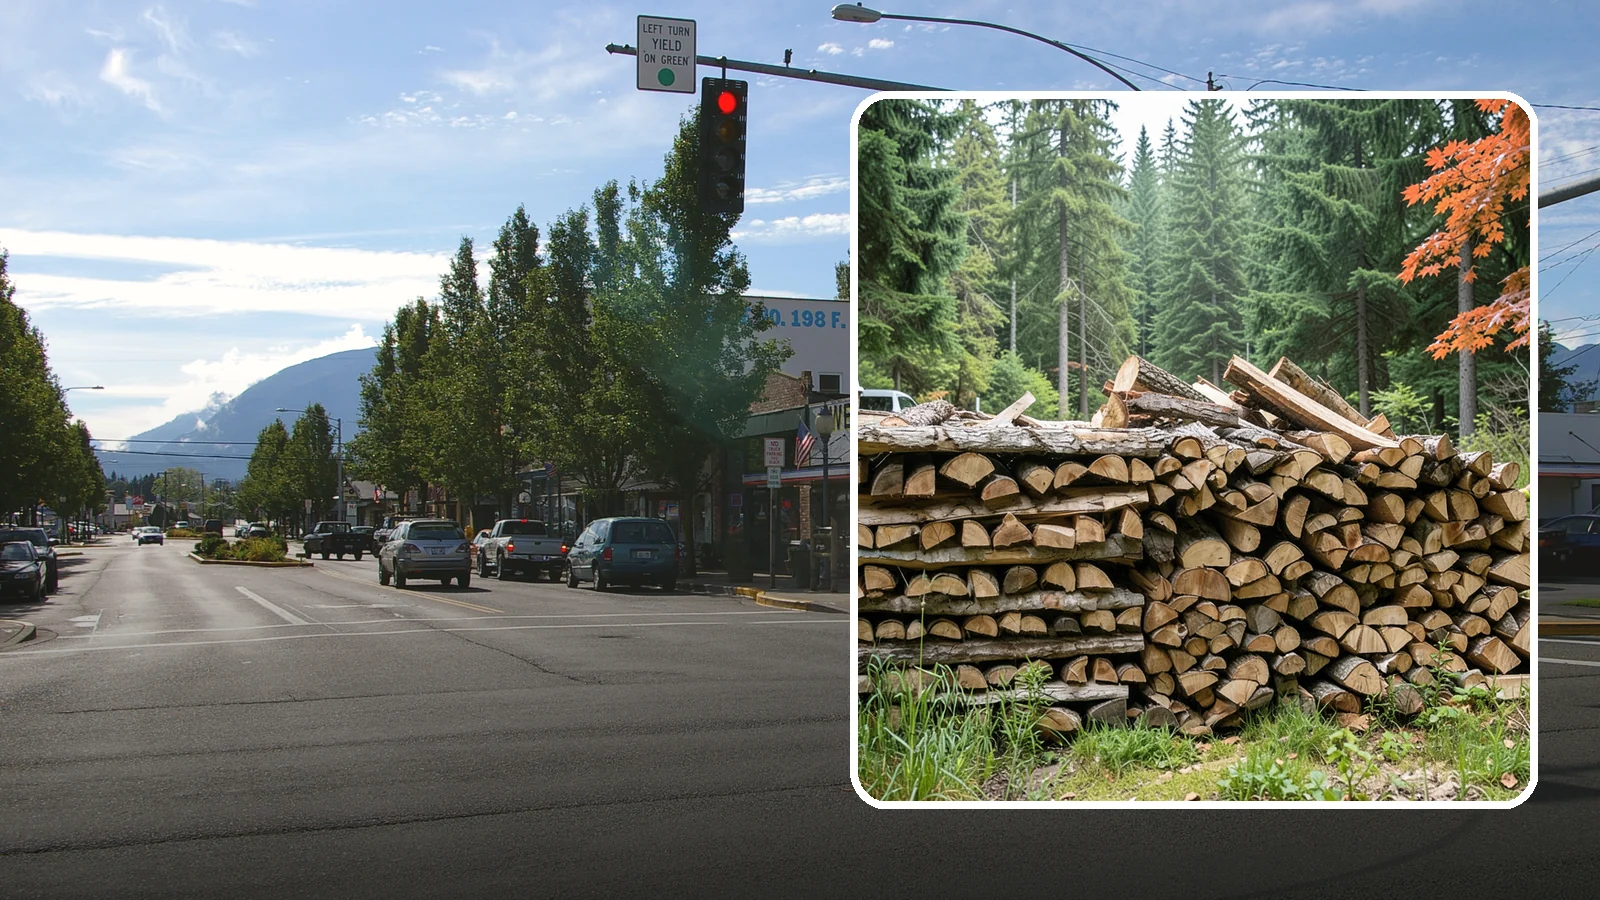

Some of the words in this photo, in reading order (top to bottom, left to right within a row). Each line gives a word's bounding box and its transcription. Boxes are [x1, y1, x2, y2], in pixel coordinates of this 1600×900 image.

[643, 23, 663, 35] LEFT
[668, 25, 690, 37] TURN
[652, 38, 682, 52] YIELD
[644, 53, 656, 64] ON
[661, 54, 689, 66] GREEN
[791, 309, 826, 328] 198
[831, 311, 846, 329] F.
